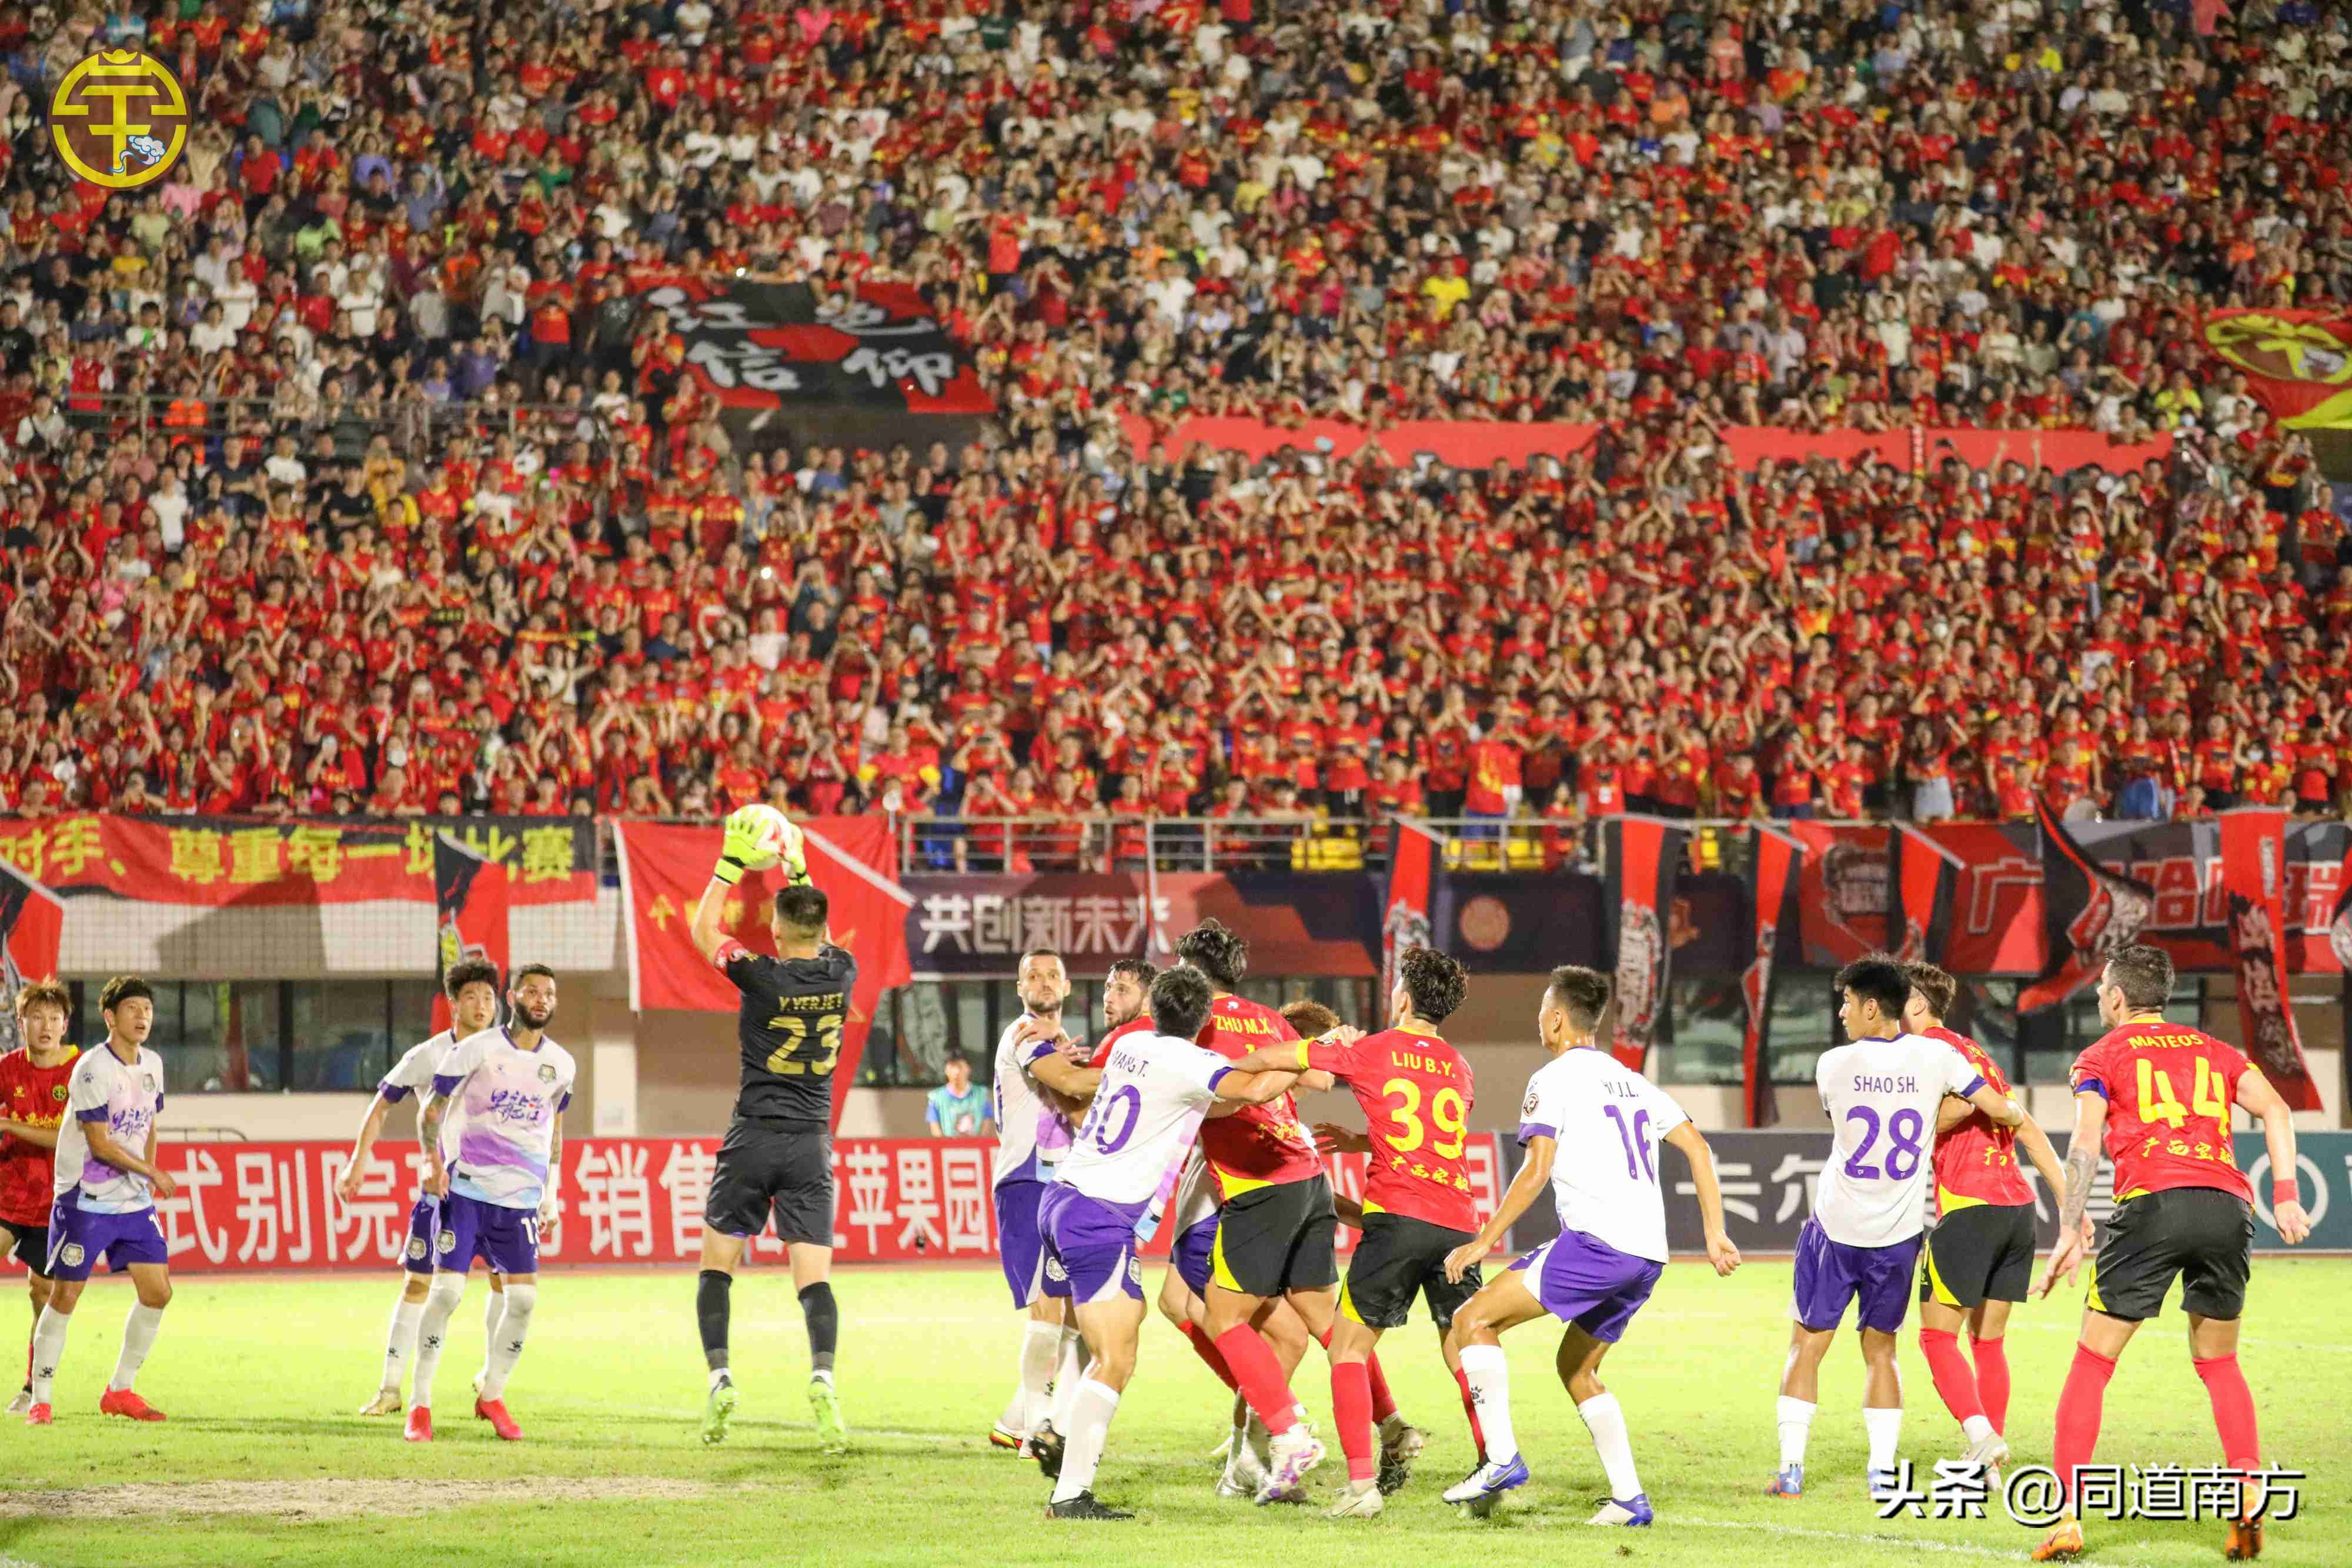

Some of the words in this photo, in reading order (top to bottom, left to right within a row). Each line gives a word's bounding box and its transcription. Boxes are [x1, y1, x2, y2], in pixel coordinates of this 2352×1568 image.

[920, 893, 1170, 955] 共创新未来
[766, 1014, 844, 1076] 23
[1213, 1015, 1242, 1034] ZHU
[1243, 1017, 1274, 1034] M.X.
[2127, 1034, 2204, 1049] MATEOS
[1392, 1051, 1421, 1070] LIU
[1425, 1057, 1457, 1079] B.Y.
[1853, 1075, 1893, 1094] SHAO
[1897, 1076, 1919, 1094] SH.
[1382, 1078, 1468, 1160] 39
[2136, 1055, 2230, 1138] 44
[1844, 1105, 1924, 1181] 28
